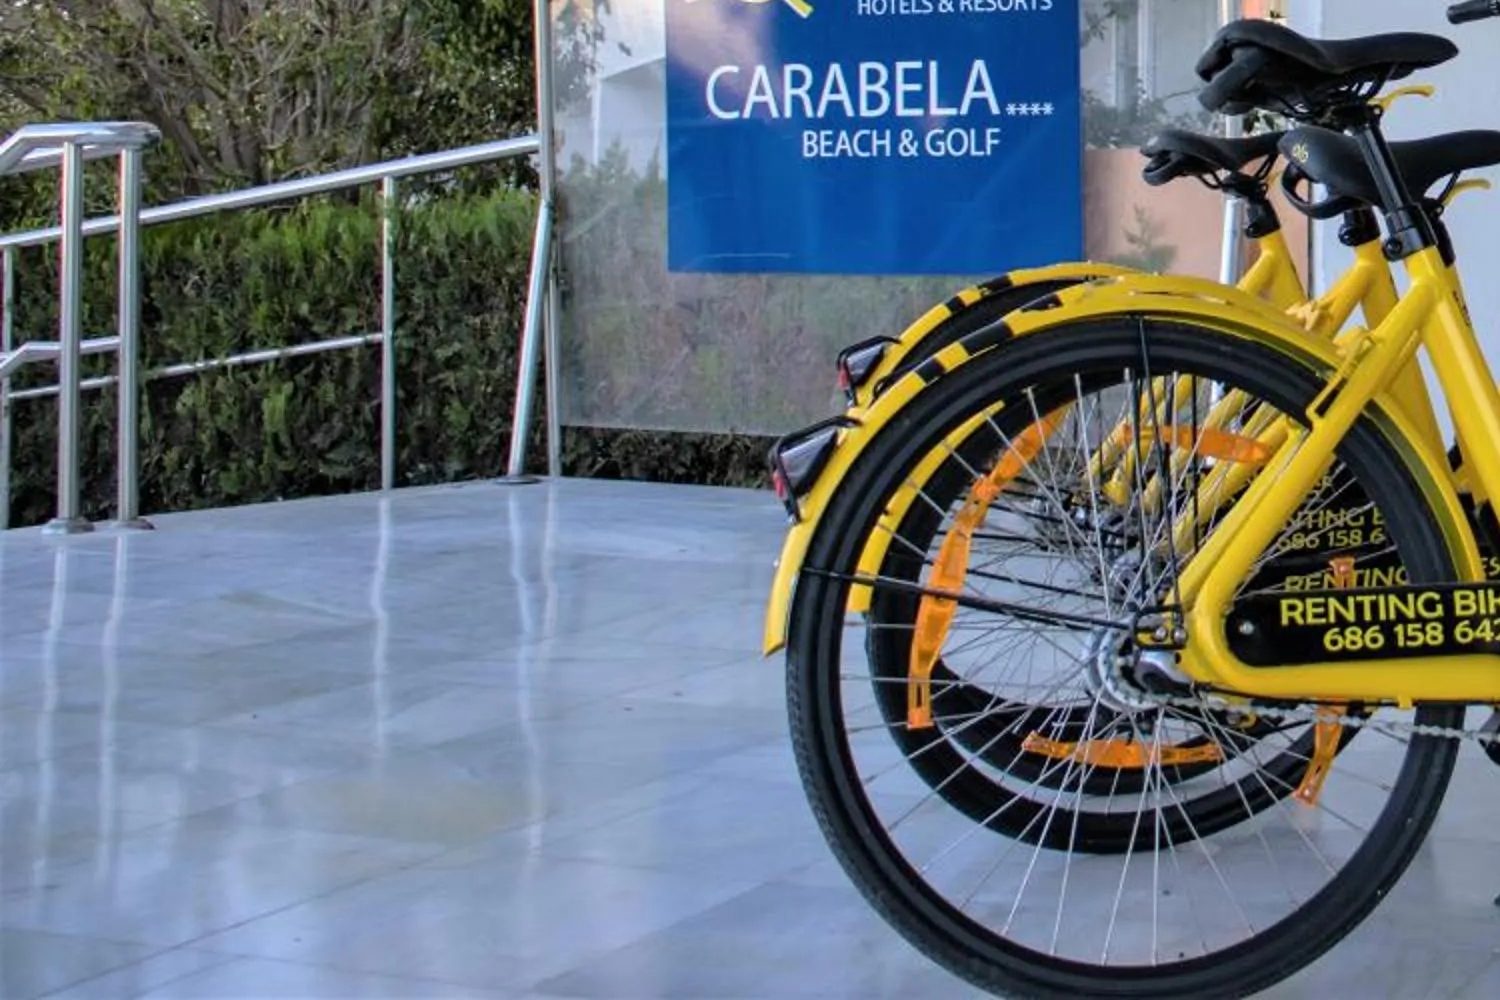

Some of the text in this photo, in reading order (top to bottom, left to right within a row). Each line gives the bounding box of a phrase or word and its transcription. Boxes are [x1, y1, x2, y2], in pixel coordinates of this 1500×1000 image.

[705, 59, 1001, 120] CARABELA
[803, 127, 1001, 158] BEACH & GOLF
[1327, 529, 1363, 548] 158
[1280, 591, 1444, 626] RENTING
[1323, 625, 1385, 652] 686
[1394, 621, 1445, 648] 158
